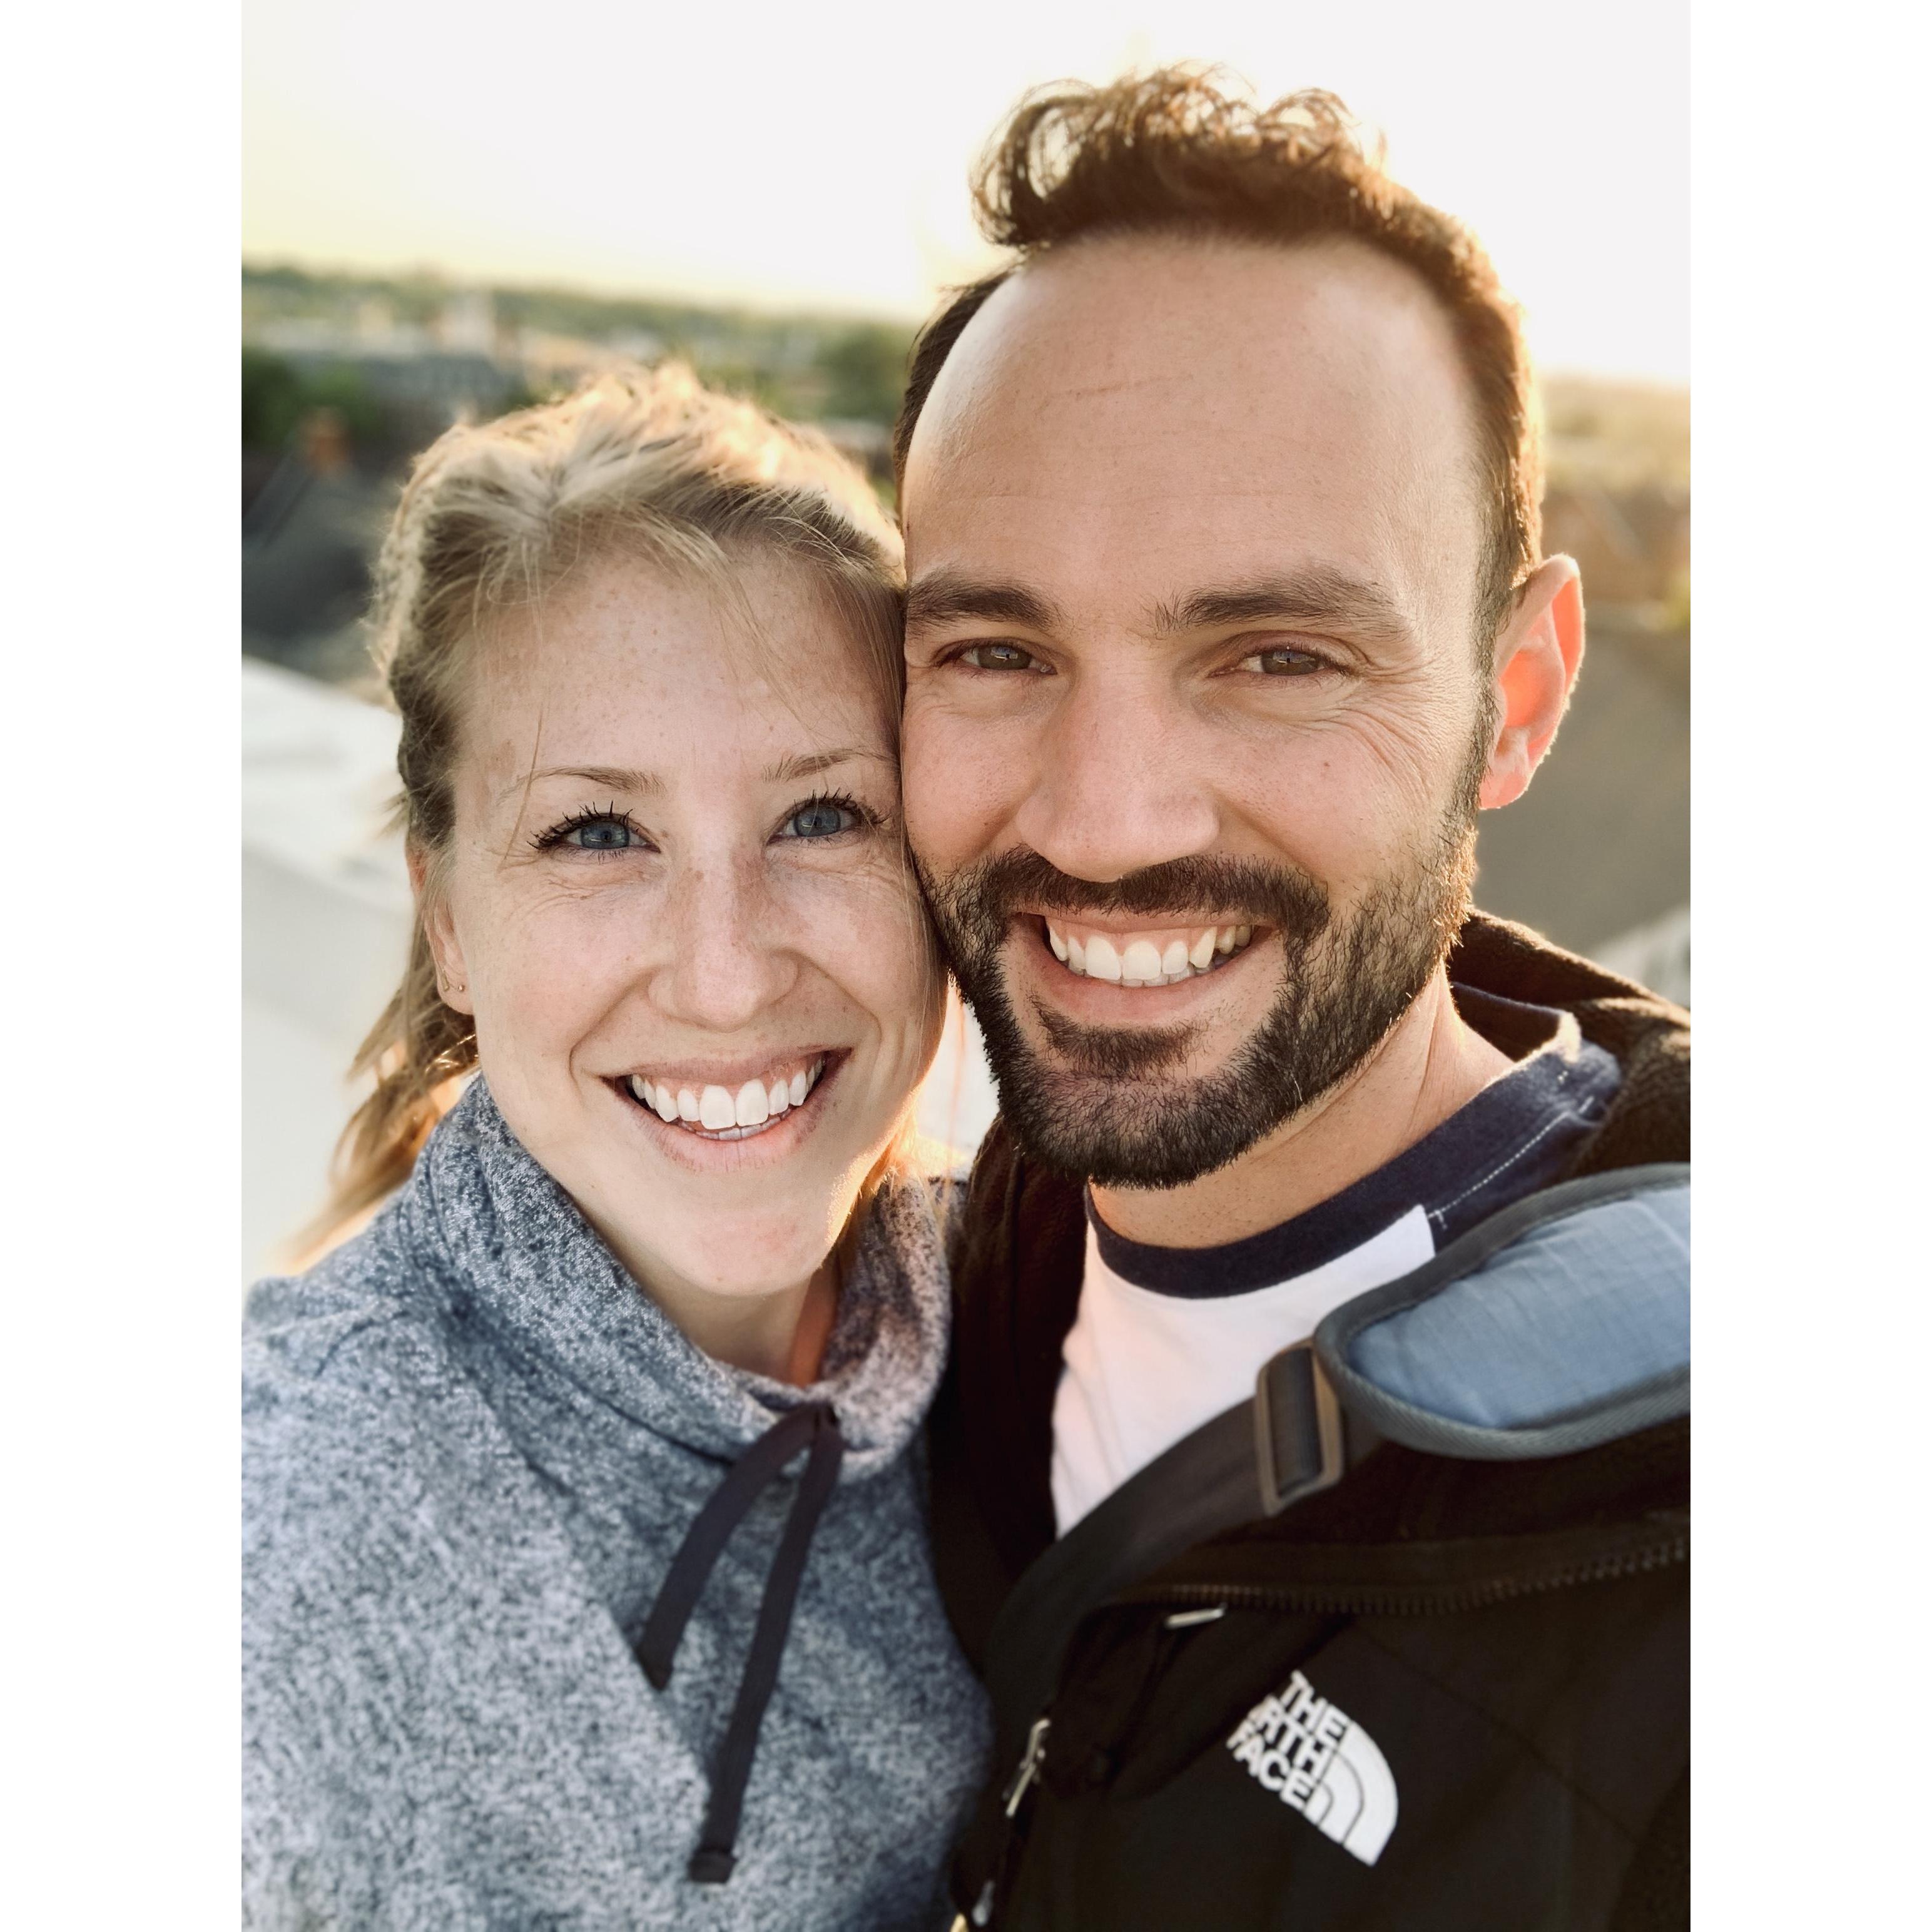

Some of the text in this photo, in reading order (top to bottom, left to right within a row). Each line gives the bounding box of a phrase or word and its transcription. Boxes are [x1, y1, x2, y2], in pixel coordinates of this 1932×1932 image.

[1248, 1696, 1333, 1779] RTH
[1280, 1669, 1349, 1749] THE
[1227, 1720, 1315, 1810] FACE
